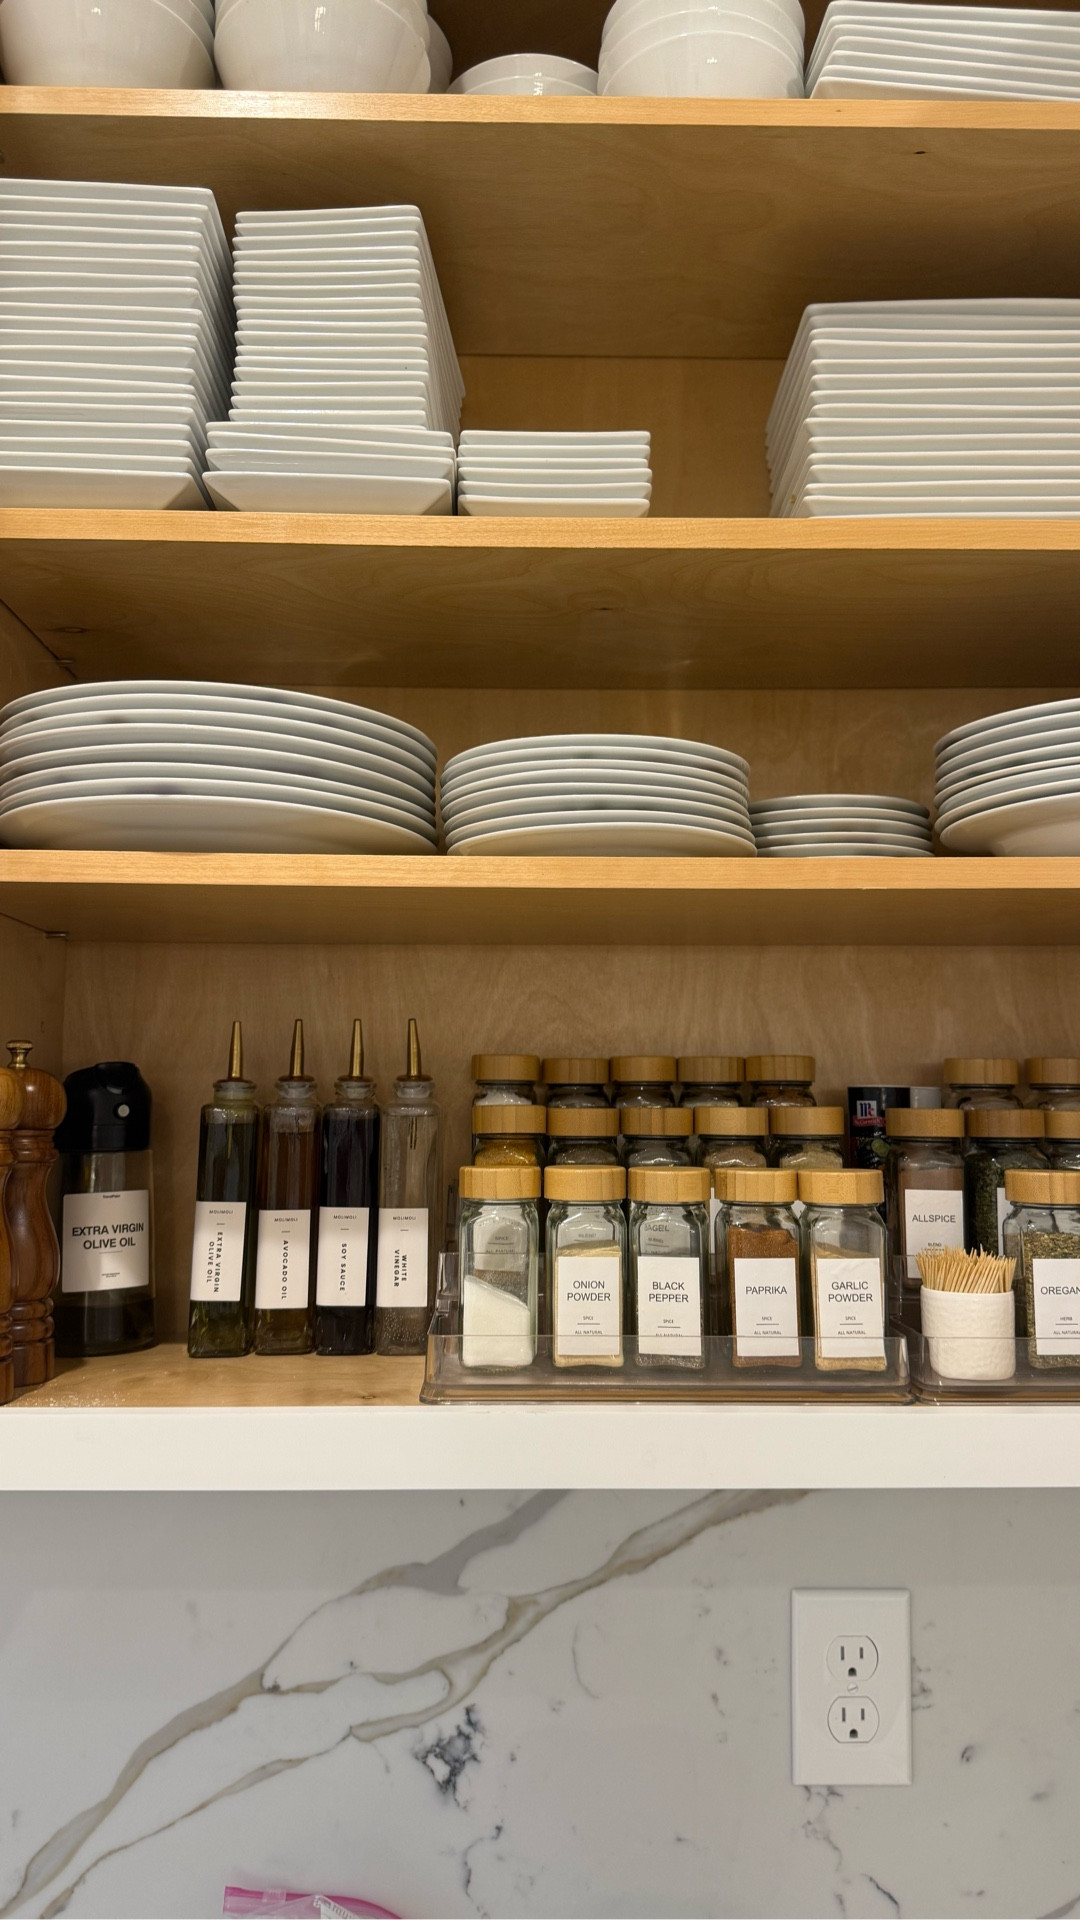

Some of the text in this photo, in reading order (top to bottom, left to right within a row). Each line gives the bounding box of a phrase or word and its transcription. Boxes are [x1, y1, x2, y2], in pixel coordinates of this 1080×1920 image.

[912, 1214, 956, 1223] ALLSPICE
[72, 1222, 144, 1237] EXTRA VIRGIN
[83, 1237, 136, 1250] OLIVE OIL
[207, 1241, 215, 1265] OLIVE
[213, 1232, 223, 1293] EXTRA VIRGIN
[281, 1240, 289, 1283] AVOCADO
[339, 1263, 347, 1291] SAUCE
[573, 1280, 605, 1289] ONION
[652, 1281, 685, 1290] BLACK
[831, 1281, 868, 1290] GARLIC
[745, 1286, 787, 1295] PAPRIKA
[567, 1292, 611, 1302] POWDER
[649, 1294, 689, 1303] PEPPER
[828, 1293, 873, 1302] POWDER
